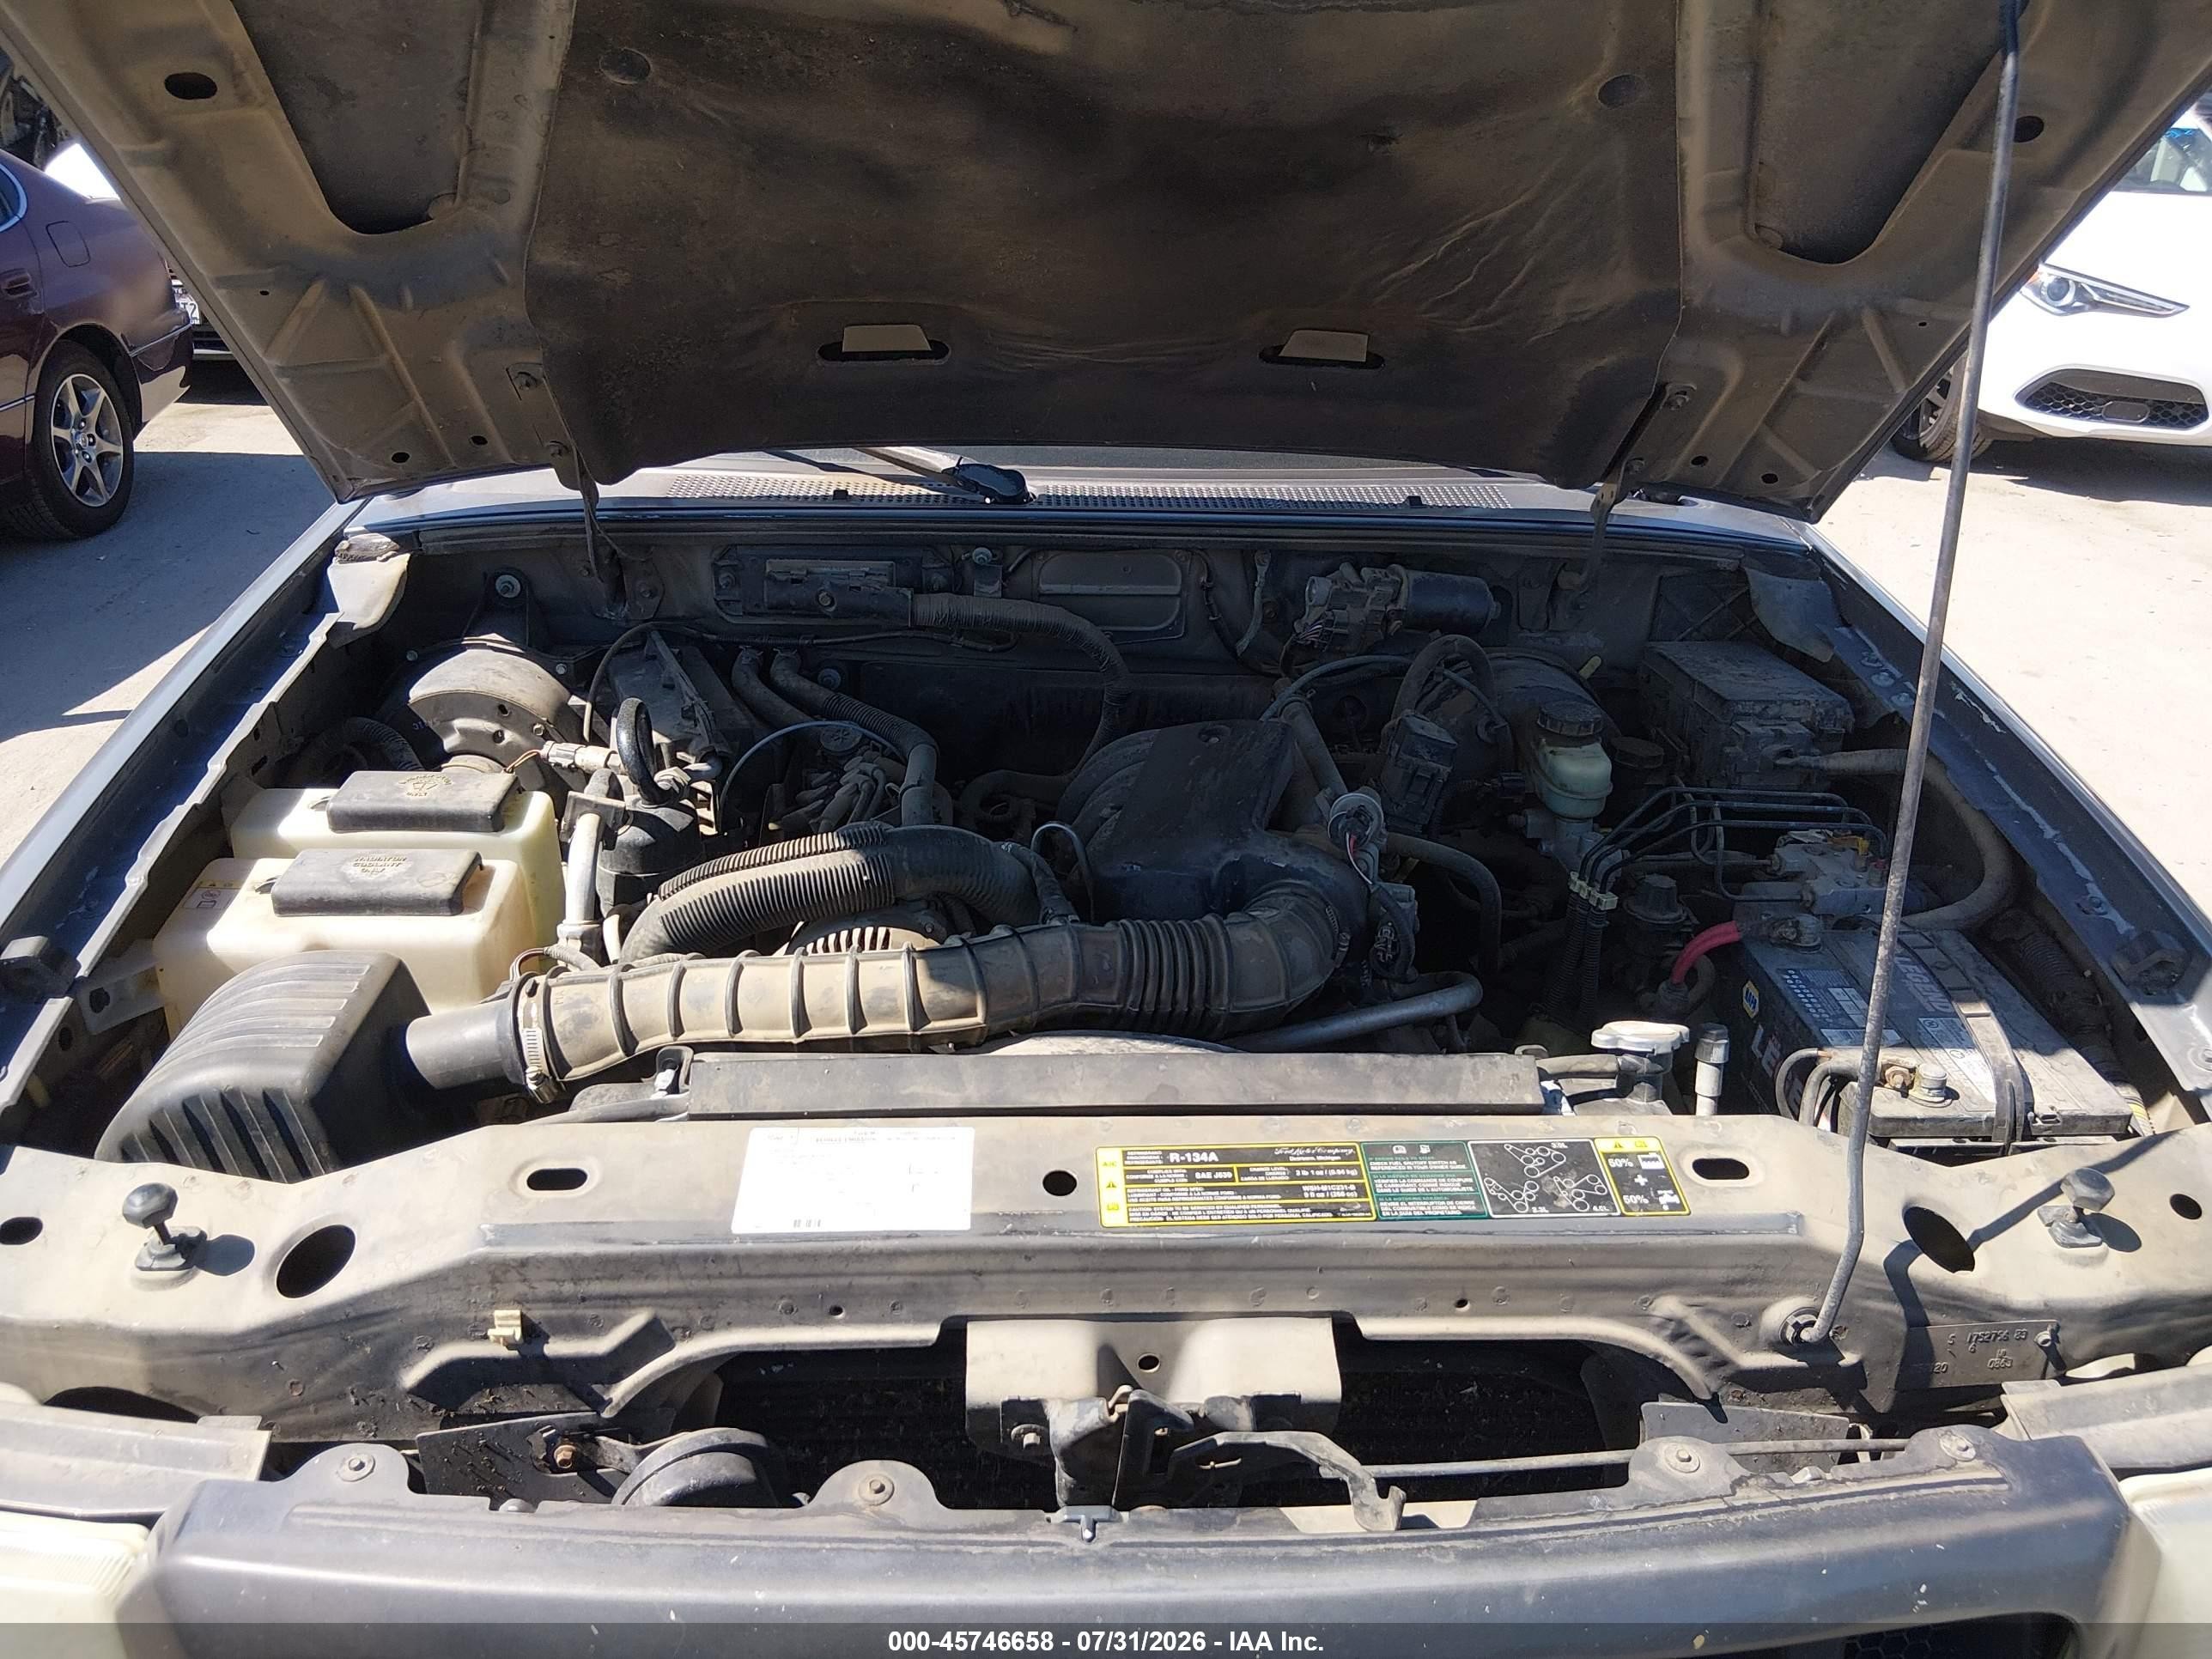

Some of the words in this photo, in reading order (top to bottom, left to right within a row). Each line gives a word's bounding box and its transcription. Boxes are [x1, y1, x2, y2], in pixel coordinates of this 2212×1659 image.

[1169, 1152, 1219, 1163] R-134A
[1607, 1158, 1633, 1168] 50%
[1622, 1194, 1649, 1205] 50%
